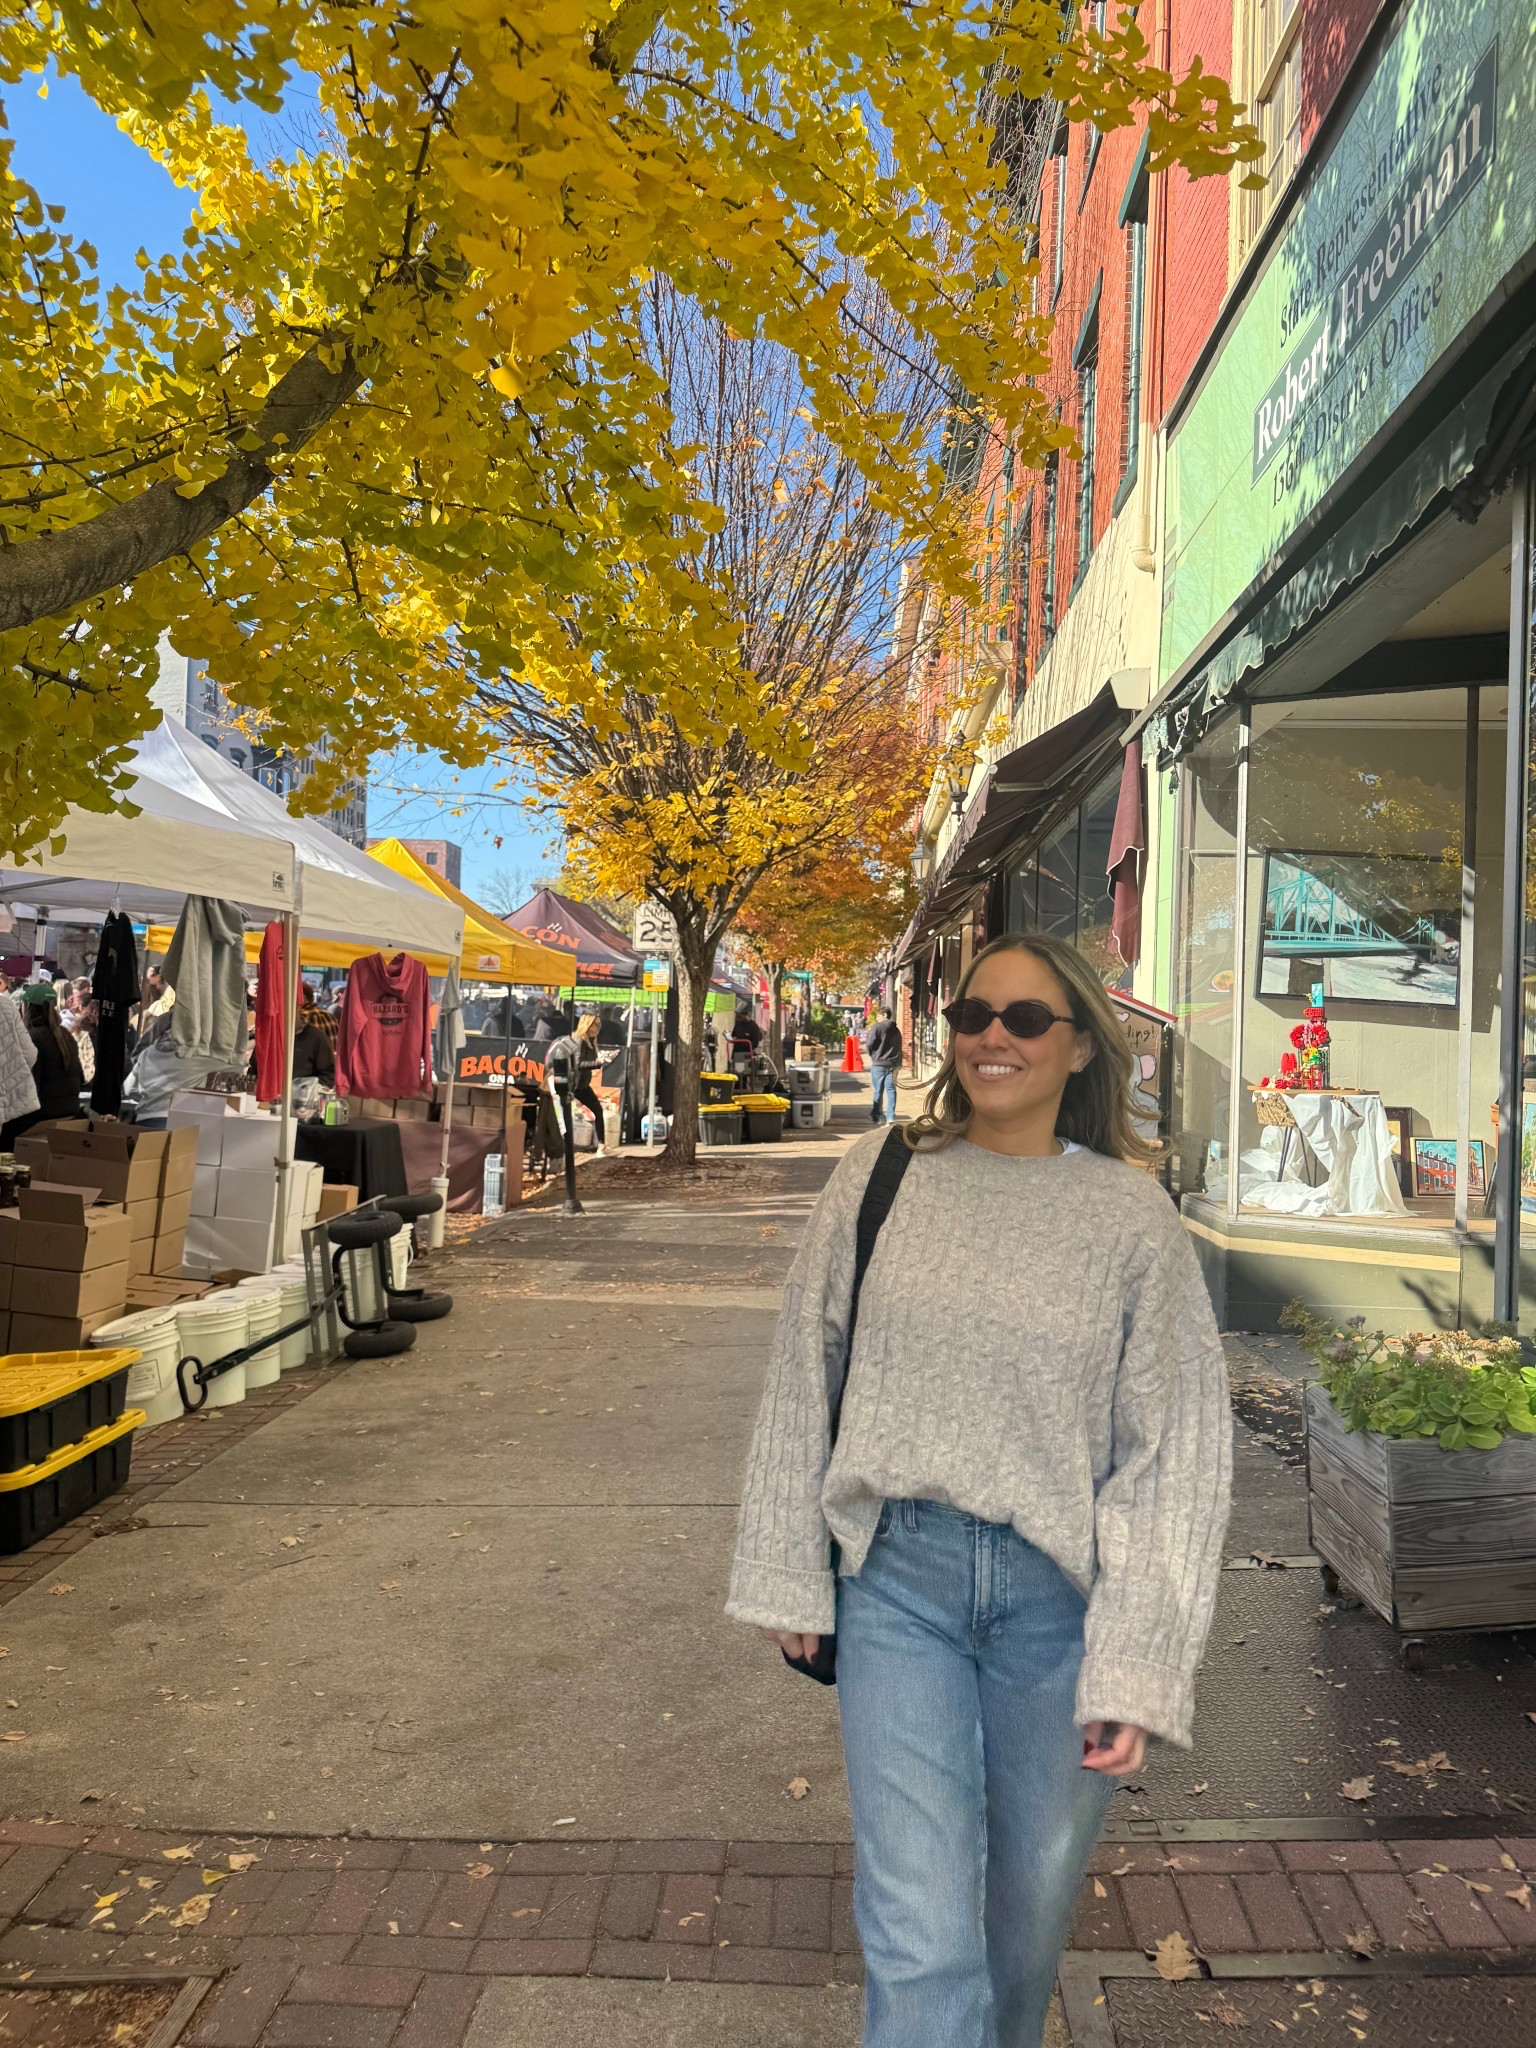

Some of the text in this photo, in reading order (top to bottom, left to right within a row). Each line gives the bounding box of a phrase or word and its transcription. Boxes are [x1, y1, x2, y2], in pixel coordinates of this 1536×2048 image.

[1281, 64, 1442, 348] State Representative
[1257, 103, 1482, 465] Robert Freeman
[1313, 354, 1375, 458] District
[1381, 272, 1443, 369] Office
[644, 905, 672, 917] LIMI
[514, 926, 580, 949] CON
[640, 921, 673, 942] 25
[577, 963, 615, 980] ICK
[373, 1004, 409, 1014] HAZARD'S
[460, 1055, 545, 1083] BACON
[489, 1073, 515, 1084] ON A
